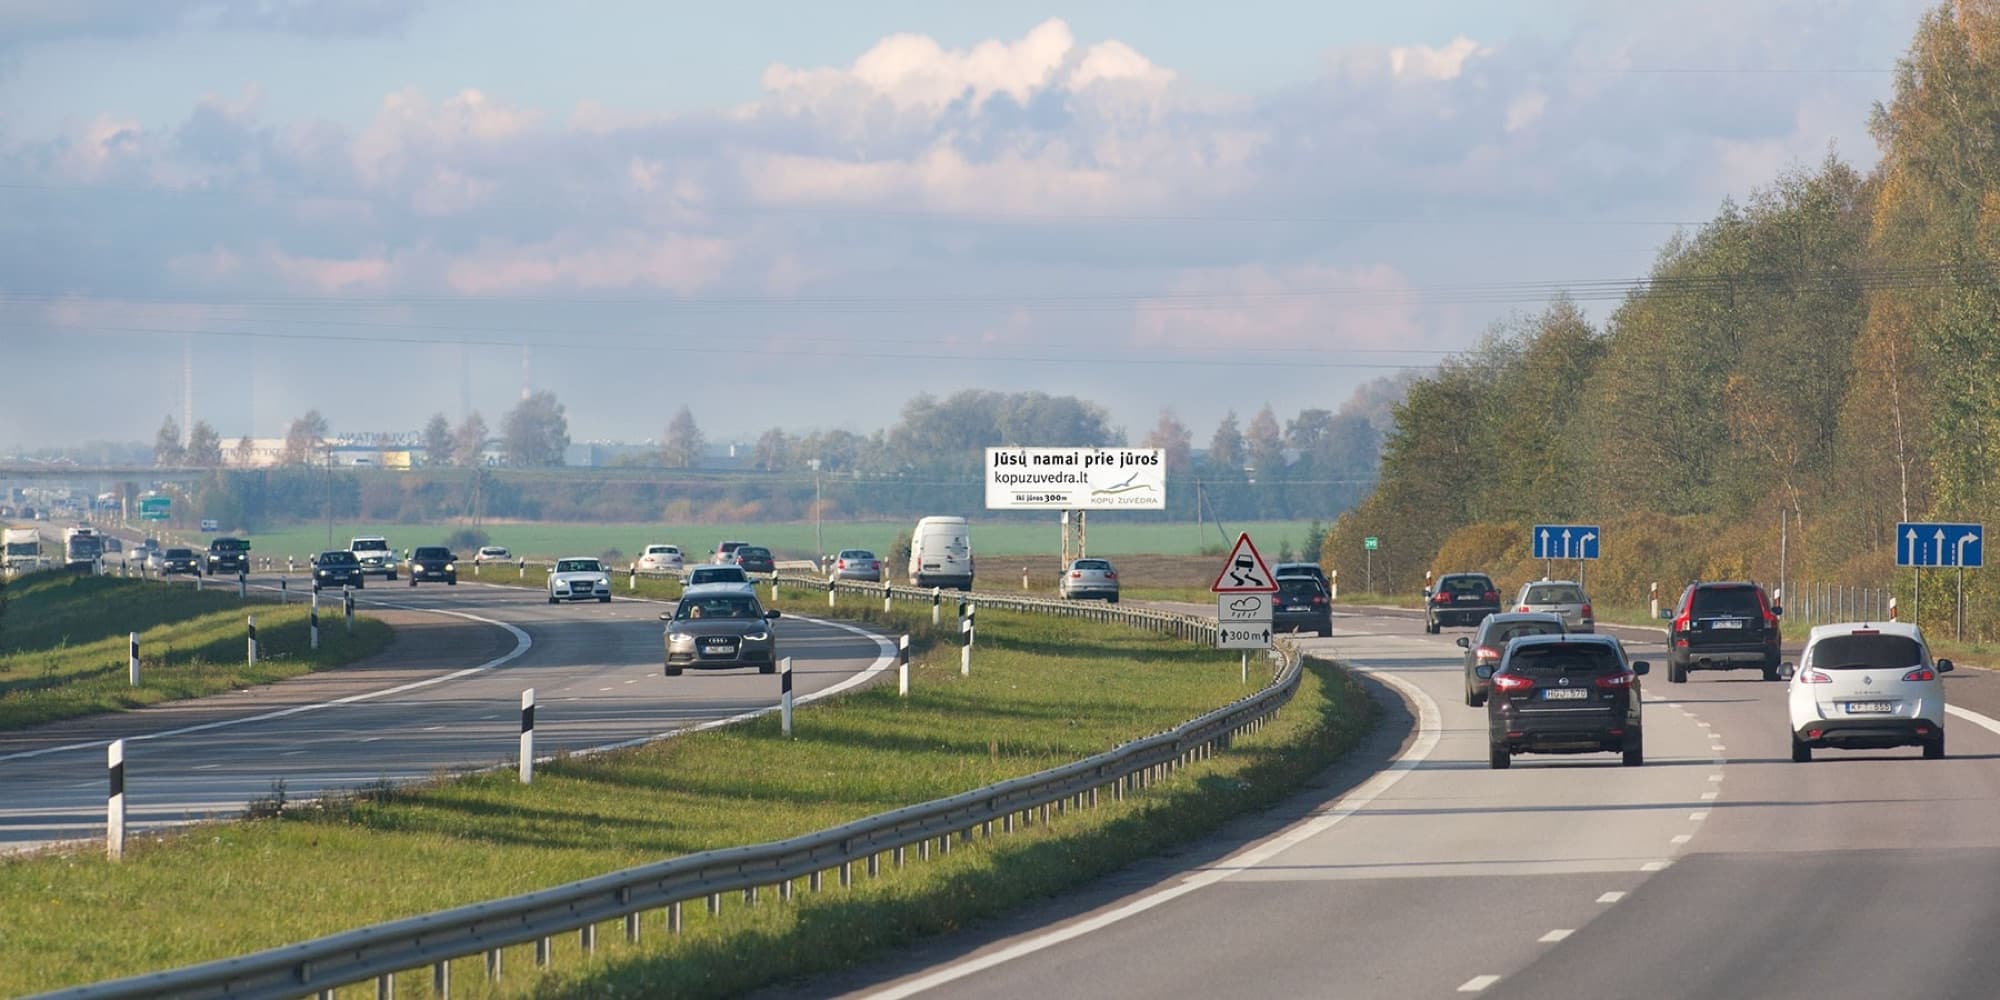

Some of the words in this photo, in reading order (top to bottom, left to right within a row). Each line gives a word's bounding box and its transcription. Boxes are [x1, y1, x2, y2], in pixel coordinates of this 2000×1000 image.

[994, 451, 1027, 468] Jūsų
[1033, 451, 1079, 465] namai
[1085, 451, 1114, 468] prie
[1120, 451, 1158, 468] jūros
[995, 471, 1088, 486] kopuzuvedra.lt
[1229, 631, 1250, 640] 300
